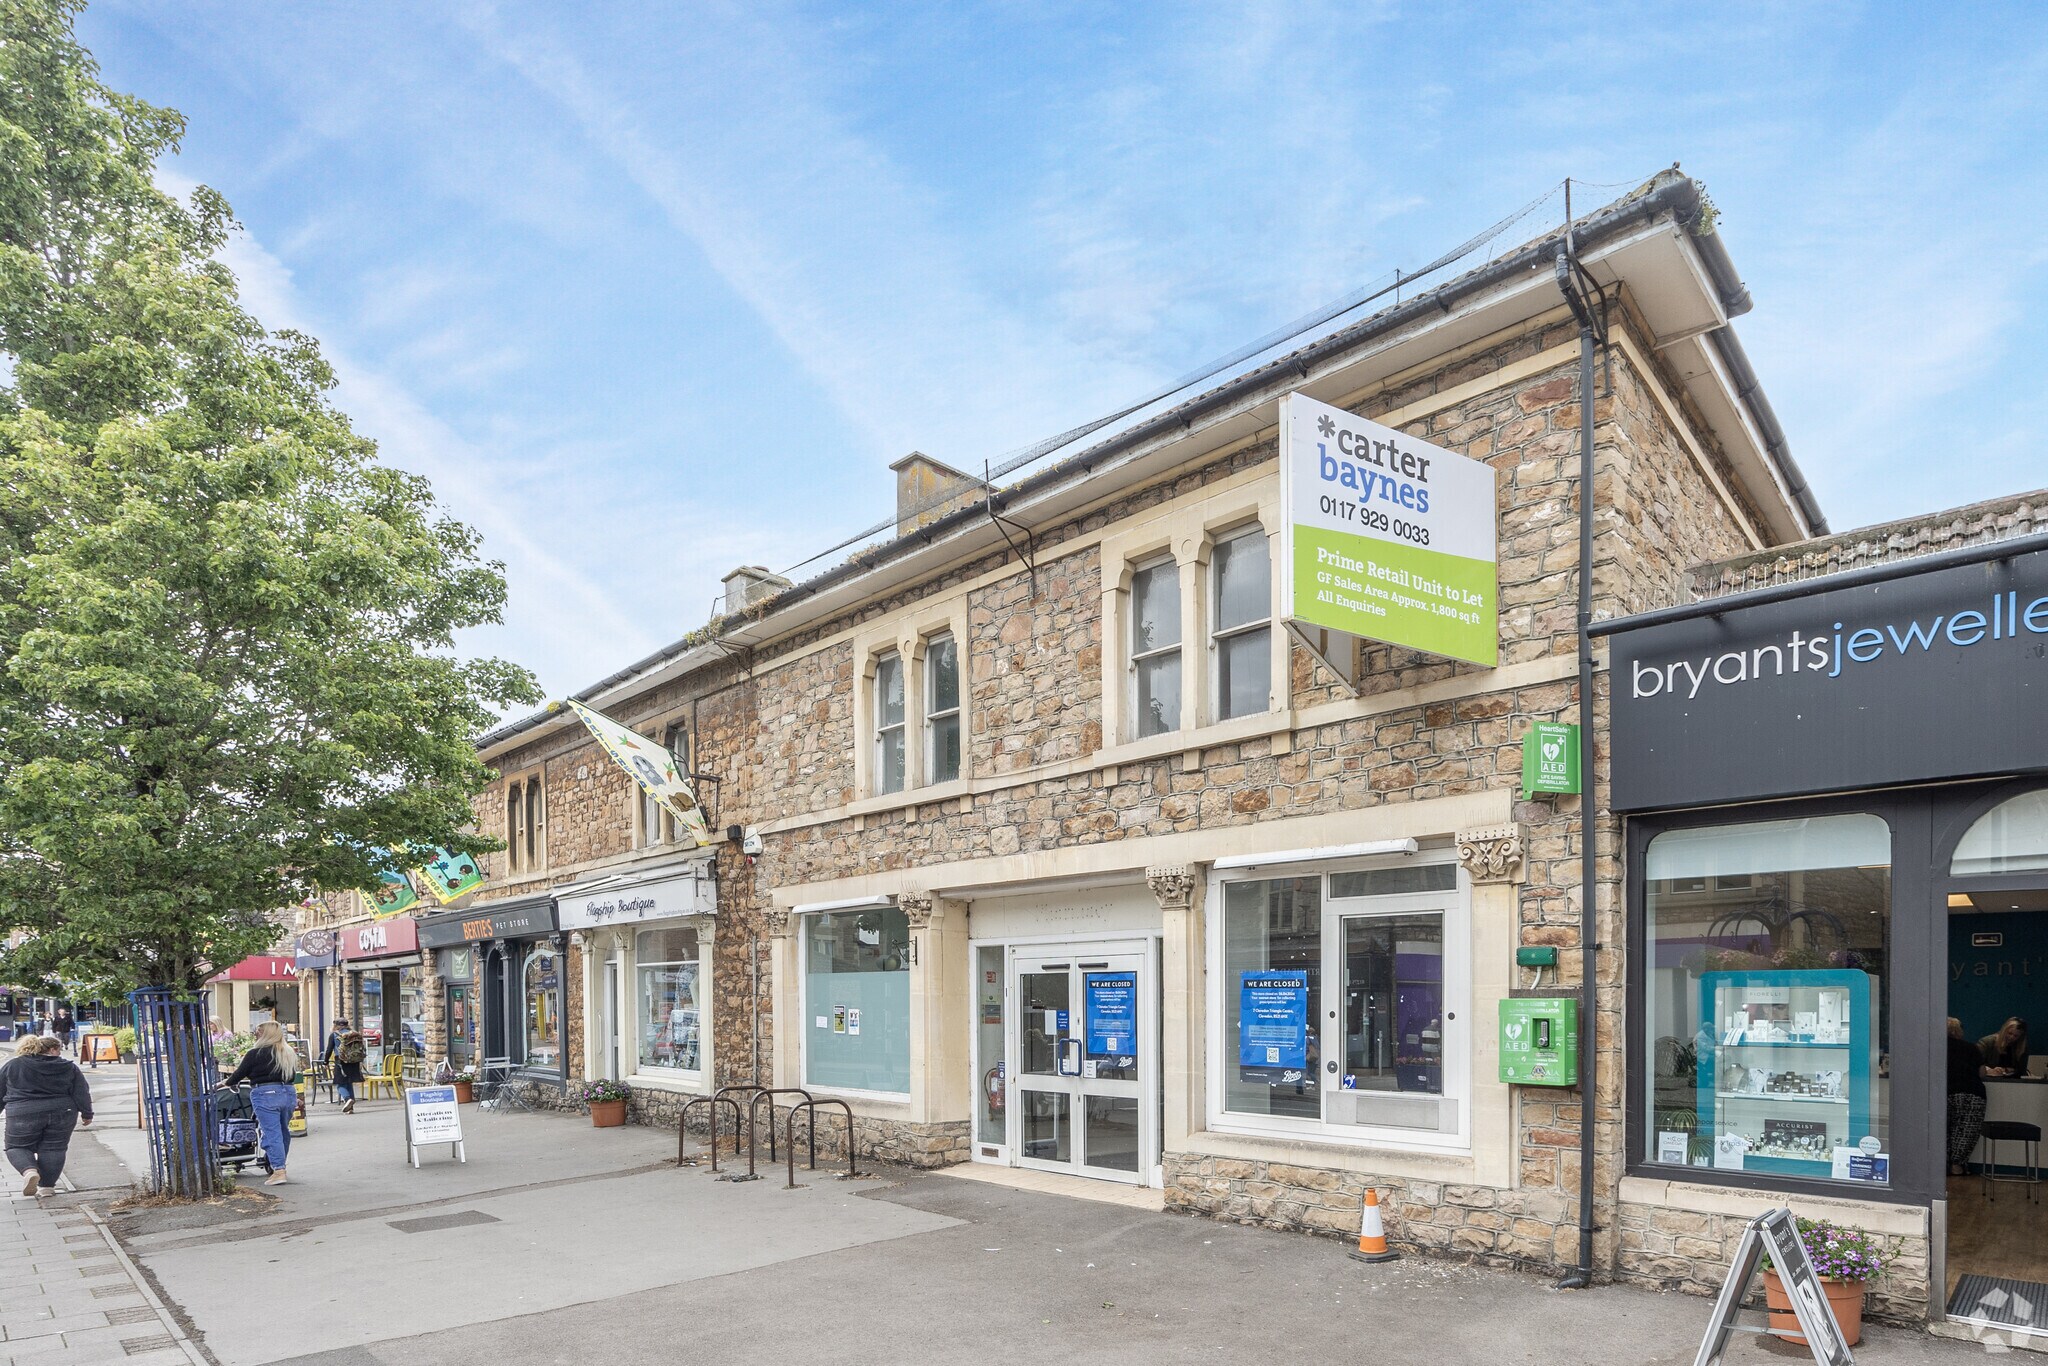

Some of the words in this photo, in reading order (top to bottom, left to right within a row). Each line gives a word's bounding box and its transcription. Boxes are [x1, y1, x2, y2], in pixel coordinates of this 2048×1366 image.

[1317, 443, 1430, 514] baynes
[1320, 495, 1356, 521] 0117
[1360, 508, 1389, 532] 929
[1393, 519, 1430, 546] 0033
[1317, 546, 1364, 573] Prime
[1367, 560, 1409, 587] Retail
[1412, 574, 1443, 597] Unit
[1445, 585, 1459, 601] to
[1462, 589, 1483, 607] Let
[1317, 571, 1332, 584] GF
[1334, 576, 1362, 592] Sales
[1364, 584, 1389, 600] Area
[1391, 591, 1430, 611] Approx.
[1431, 603, 1457, 619] 1,800
[1459, 611, 1470, 624] sq
[1471, 612, 1481, 624] ft
[1317, 589, 1333, 604] All
[1336, 594, 1387, 617] Enquiries
[1543, 763, 1565, 772] AED
[586, 901, 615, 922] Flagship
[618, 897, 656, 918] Boutique
[510, 918, 529, 927] STORE
[307, 932, 328, 940] COSTA
[307, 945, 332, 954] COFFEE
[1505, 1042, 1528, 1050] AED
[1282, 1070, 1301, 1082] Boots
